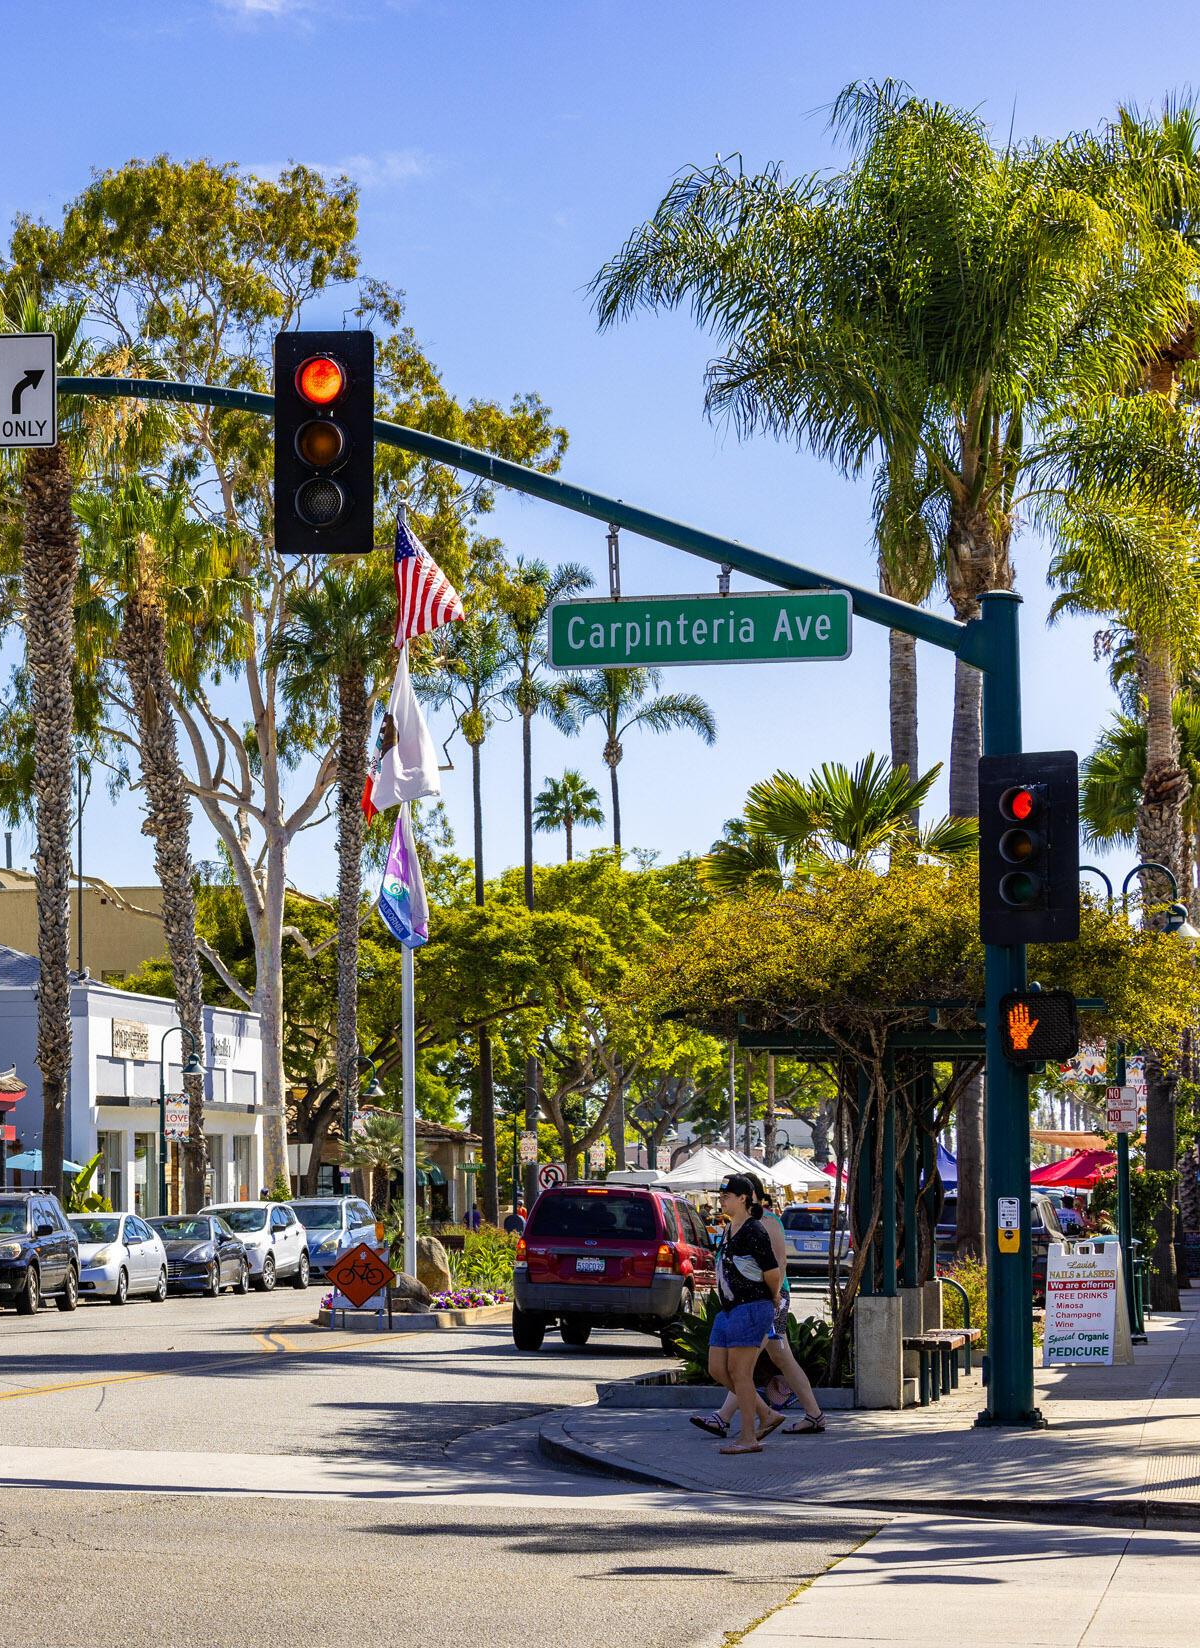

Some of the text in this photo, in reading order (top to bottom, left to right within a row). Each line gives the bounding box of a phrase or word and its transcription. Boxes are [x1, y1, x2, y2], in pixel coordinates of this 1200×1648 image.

[2, 420, 47, 437] ONLY
[567, 609, 831, 656] Carpinteria Ave
[1108, 1088, 1119, 1099] NO
[166, 1114, 188, 1122] LOVE
[1109, 1111, 1119, 1121] NO
[1067, 1261, 1097, 1269] Lavish
[1049, 1271, 1074, 1279] NAILS
[1082, 1270, 1115, 1278] LASHES
[1081, 1281, 1114, 1289] offering
[1048, 1332, 1109, 1343] Special Organic
[1048, 1347, 1109, 1357] PEDICURE
